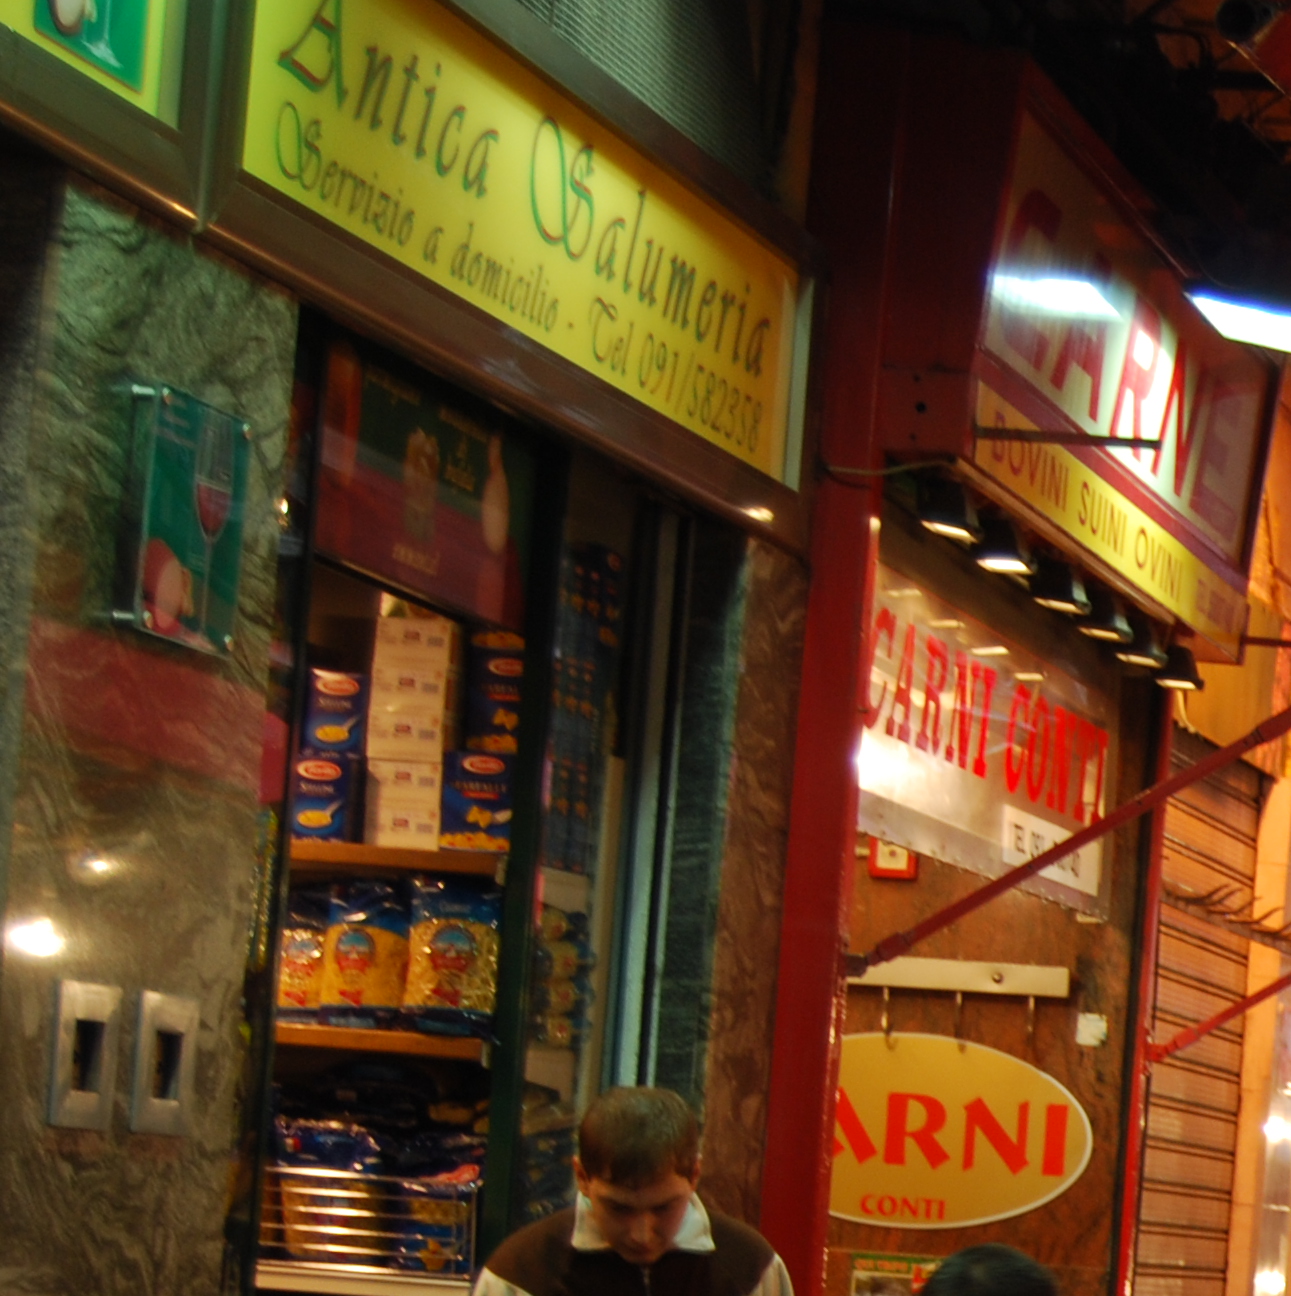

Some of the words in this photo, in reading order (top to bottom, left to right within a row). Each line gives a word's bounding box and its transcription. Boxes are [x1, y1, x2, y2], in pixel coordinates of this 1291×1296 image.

[275, 101, 416, 244] Servizio
[420, 226, 442, 262] a
[449, 222, 561, 334] domicilio
[588, 297, 635, 377] Tel
[276, 0, 499, 199] Antica
[530, 115, 771, 379] Salumeria
[991, 410, 1071, 514] BOVINI
[1077, 480, 1127, 559] SUINI
[1133, 526, 1186, 602] OVINI
[861, 606, 998, 780] CARNI
[1003, 682, 1110, 826] CONTI
[859, 1193, 947, 1221] CONTI
